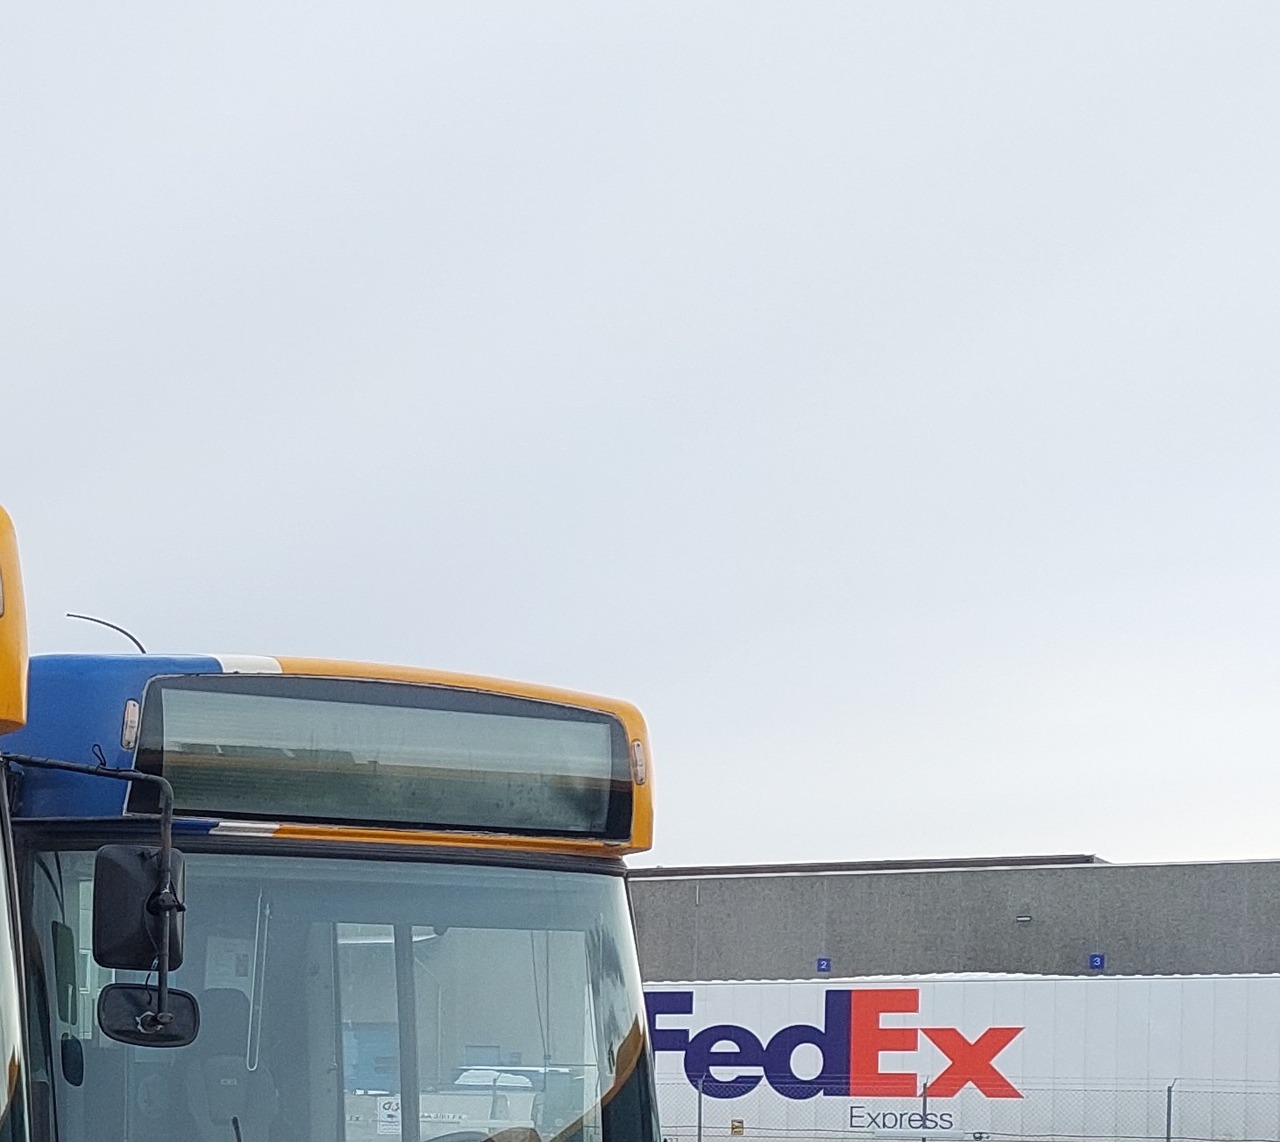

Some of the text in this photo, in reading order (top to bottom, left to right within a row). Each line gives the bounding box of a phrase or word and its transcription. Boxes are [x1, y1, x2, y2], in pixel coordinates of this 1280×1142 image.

[820, 961, 827, 969] 2
[1094, 957, 1101, 966] 3
[643, 988, 1025, 1100] FedEx
[849, 1105, 954, 1131] Express
